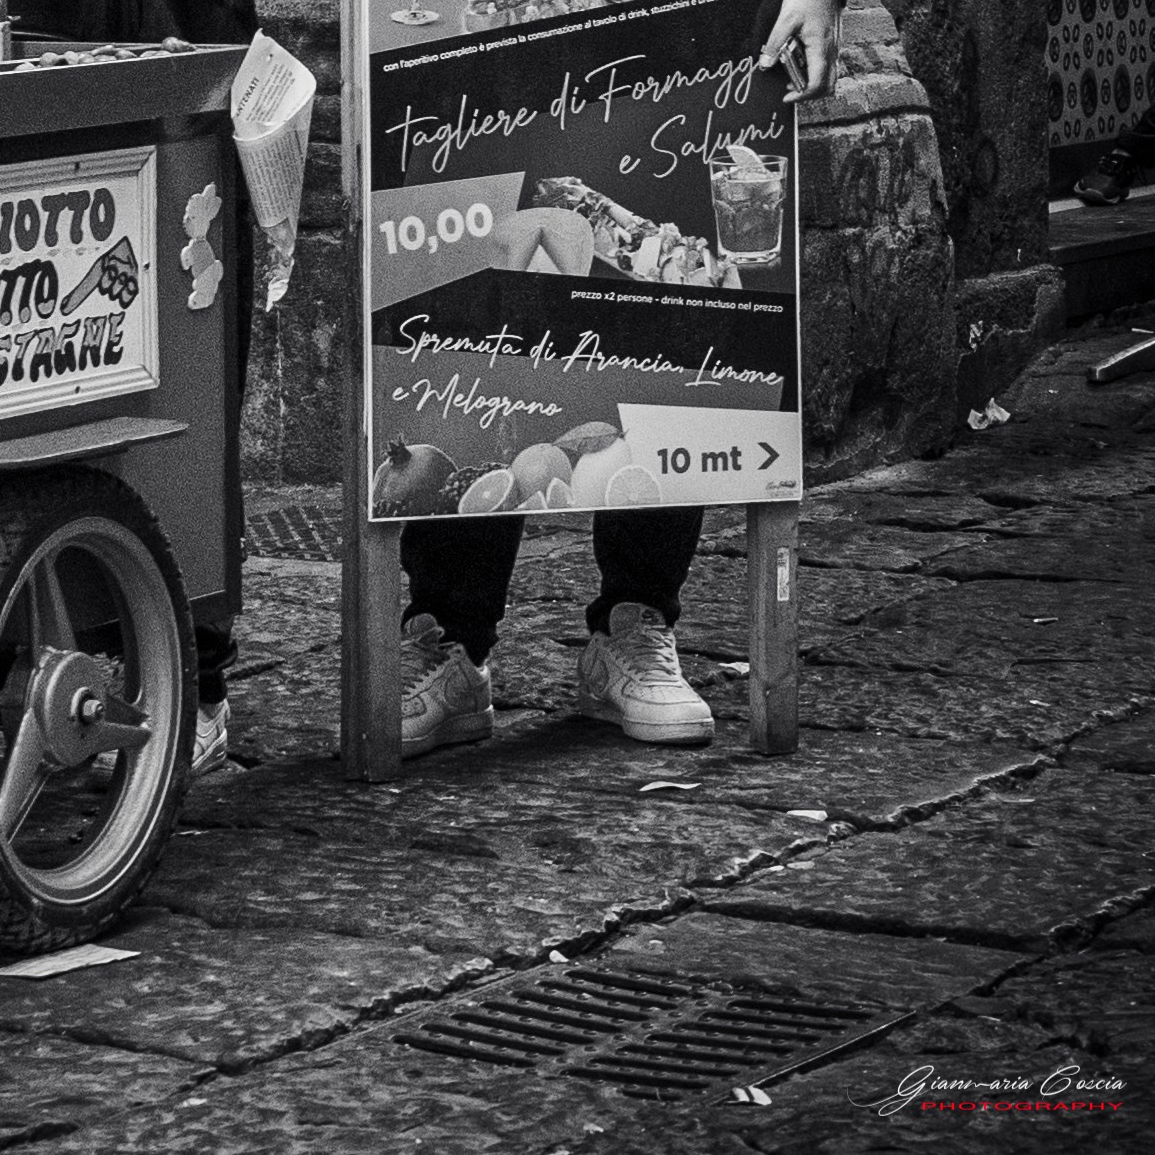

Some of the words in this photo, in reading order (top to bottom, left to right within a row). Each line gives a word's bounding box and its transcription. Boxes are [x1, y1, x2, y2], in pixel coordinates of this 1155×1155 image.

[383, 62, 399, 72] con
[440, 46, 478, 60] completo
[486, 37, 517, 51] prevista
[518, 34, 527, 43] la
[527, 23, 583, 41] consumazione
[584, 20, 592, 29] al
[593, 15, 618, 27] tavolo
[618, 12, 627, 21] di
[650, 0, 691, 15] stuzzichini
[550, 72, 586, 130] di
[584, 54, 763, 123] Formagg
[619, 154, 641, 175] e
[651, 110, 785, 179] Salumi
[379, 202, 494, 255] 10,00
[571, 290, 602, 300] prezzo
[604, 292, 615, 301] x2
[617, 293, 653, 304] persone
[661, 296, 684, 306] drink
[686, 298, 703, 307] non
[705, 298, 736, 310] incluso
[738, 301, 752, 311] nel
[753, 303, 784, 313] prezzo
[395, 314, 522, 369] Spremuta
[530, 329, 557, 369] di
[684, 346, 785, 387] Limone
[392, 386, 409, 402] e
[411, 372, 563, 429] Melograno
[657, 447, 691, 475] 10
[701, 446, 742, 473] mt
